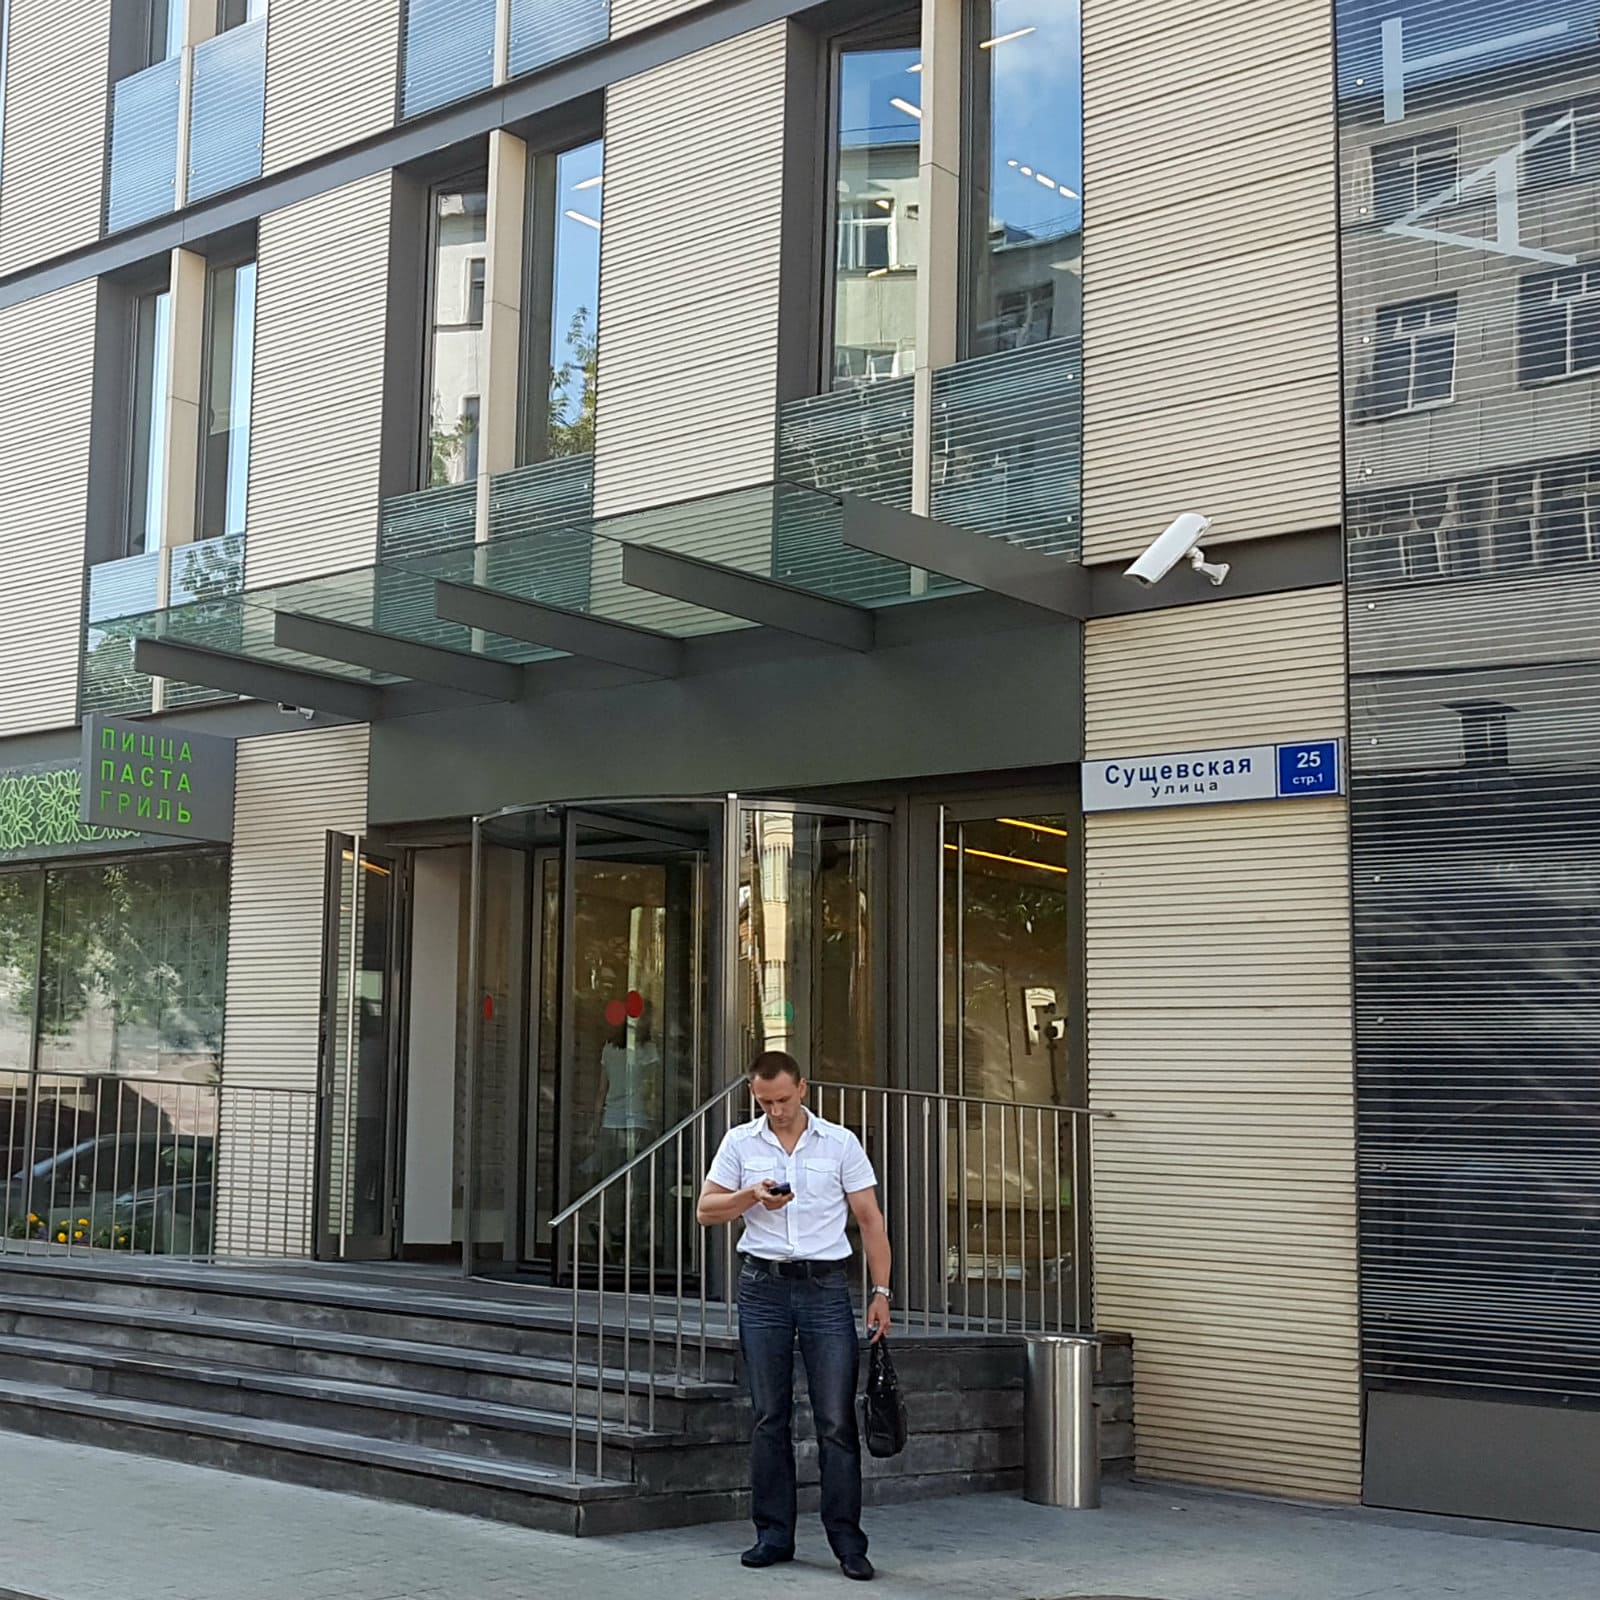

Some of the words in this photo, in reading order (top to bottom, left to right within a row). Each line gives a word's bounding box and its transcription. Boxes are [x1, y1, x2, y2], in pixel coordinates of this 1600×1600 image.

[101, 727, 192, 764] ПИЦЦА
[1296, 751, 1321, 769] 25
[101, 759, 192, 793] ПАСТА
[1104, 757, 1252, 788] Сущевская
[1292, 772, 1324, 786] стр.1
[1151, 780, 1218, 798] улица
[100, 790, 192, 824] ГРИЛЬ
